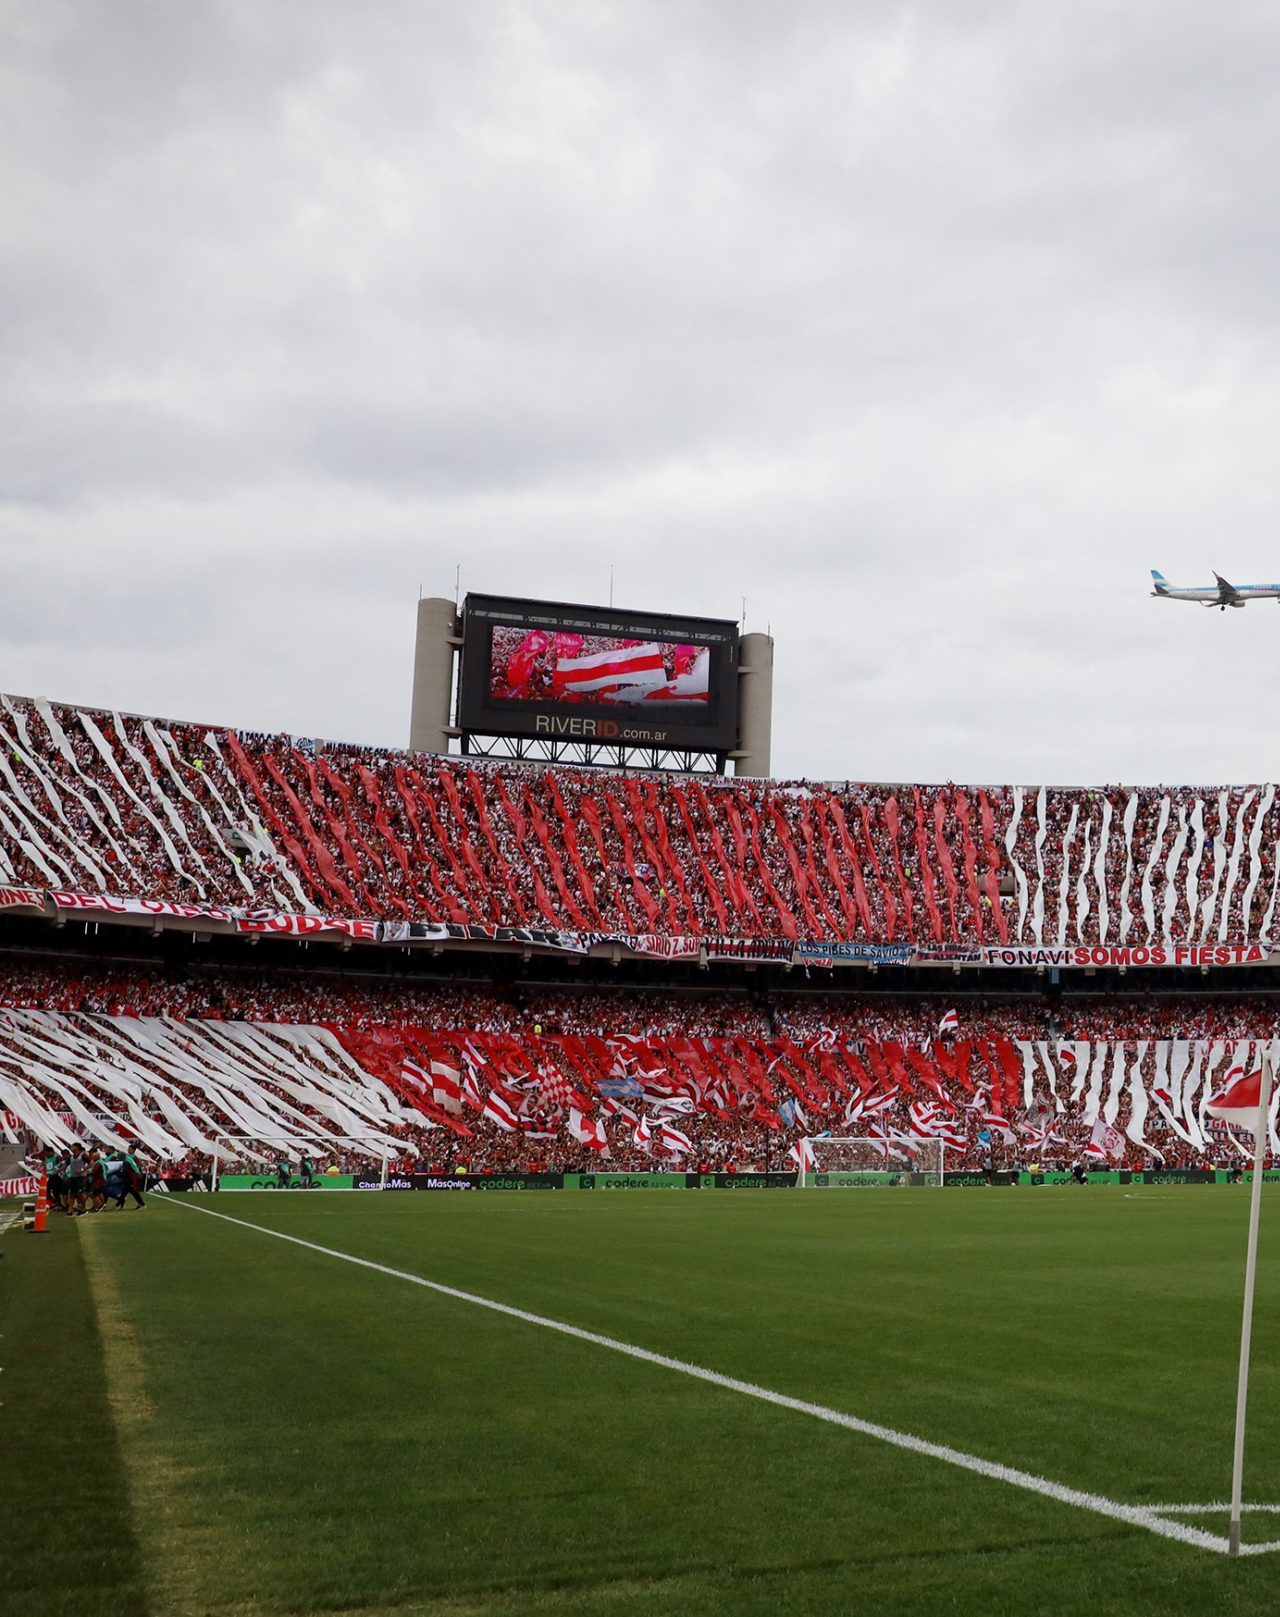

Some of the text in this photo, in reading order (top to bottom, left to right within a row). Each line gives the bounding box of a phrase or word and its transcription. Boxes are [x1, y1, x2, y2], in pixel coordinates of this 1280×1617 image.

[53, 890, 126, 913] DEL
[800, 943, 899, 959] LOS PIBES DE SAVIO
[988, 945, 1263, 966] FONAVI SOMOS FIESTA
[479, 1177, 525, 1189] codere
[606, 1177, 649, 1188] codere
[725, 1176, 767, 1187] codere
[949, 1176, 987, 1186] codere
[1152, 1174, 1187, 1183] codere
